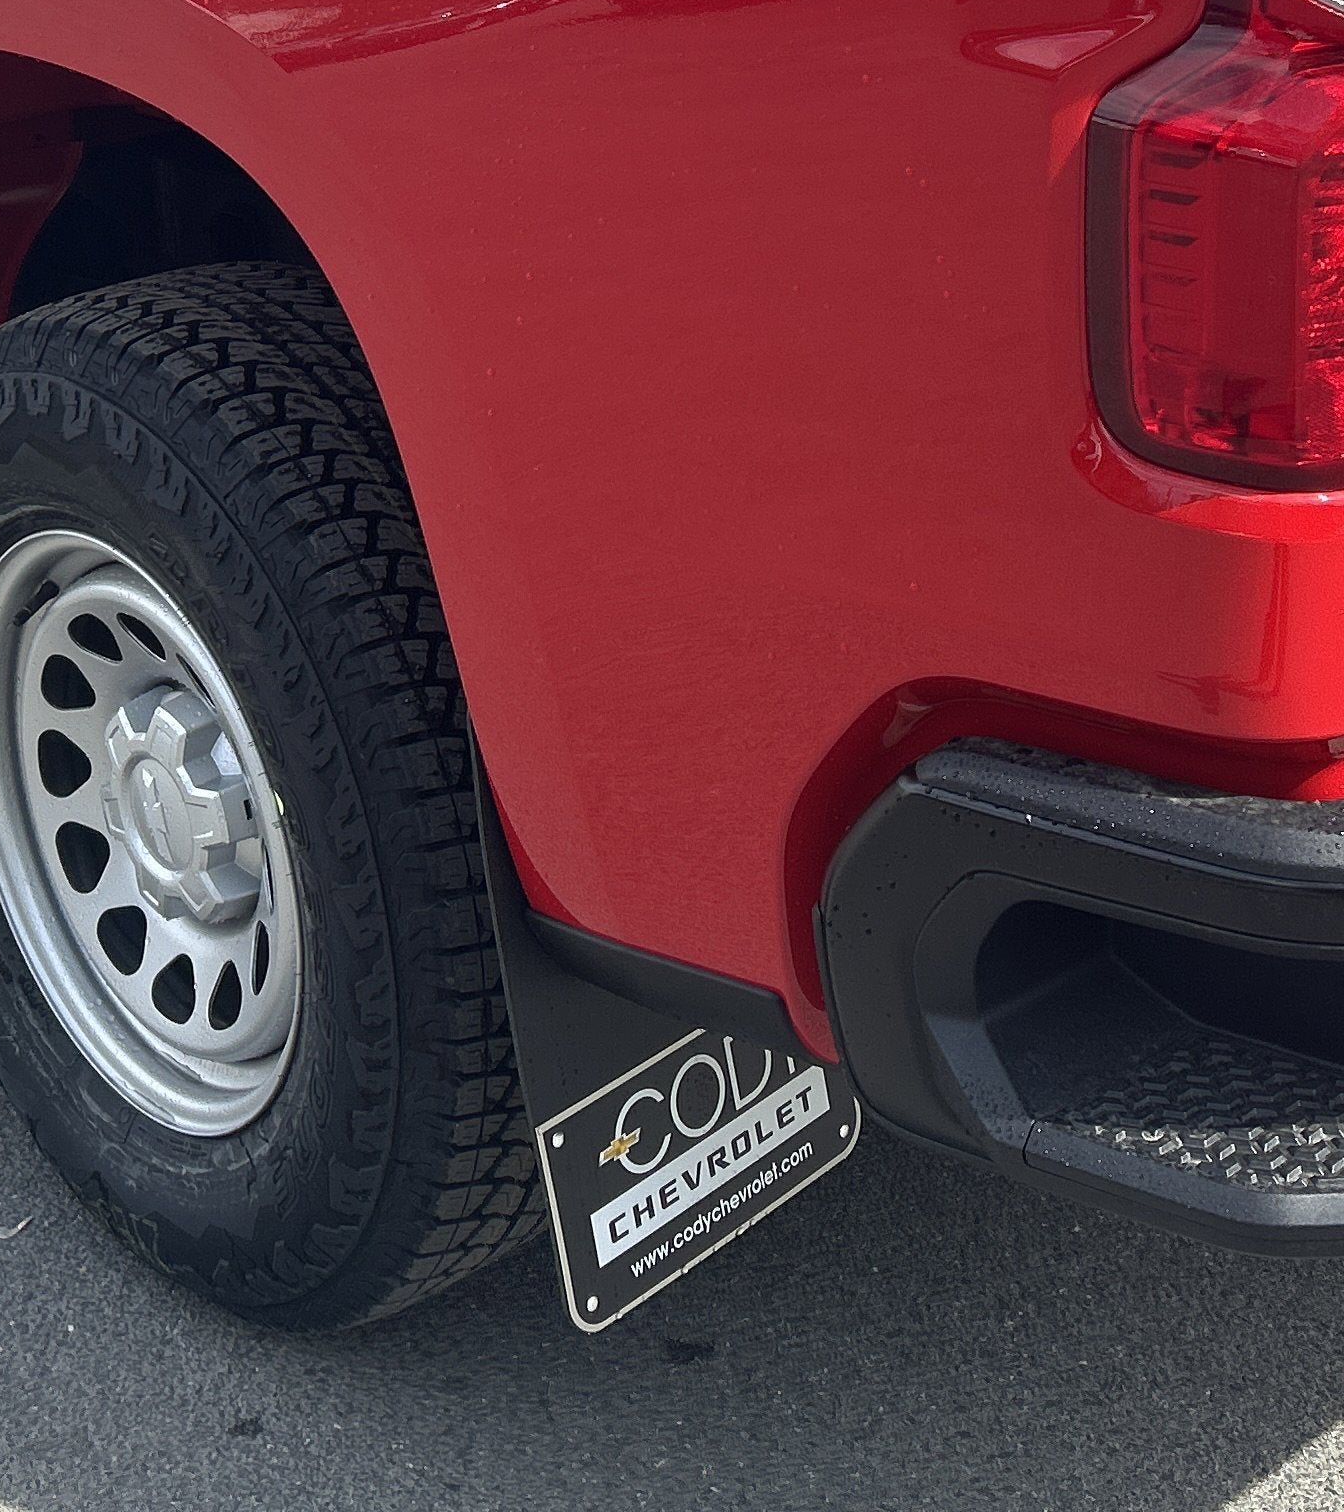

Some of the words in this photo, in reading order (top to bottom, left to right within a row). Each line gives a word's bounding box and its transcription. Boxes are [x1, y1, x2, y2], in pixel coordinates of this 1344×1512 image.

[608, 1085, 813, 1244] CHEVROLET
[615, 1035, 796, 1174] COD
[631, 1141, 814, 1278] www.codychevrolet.com
